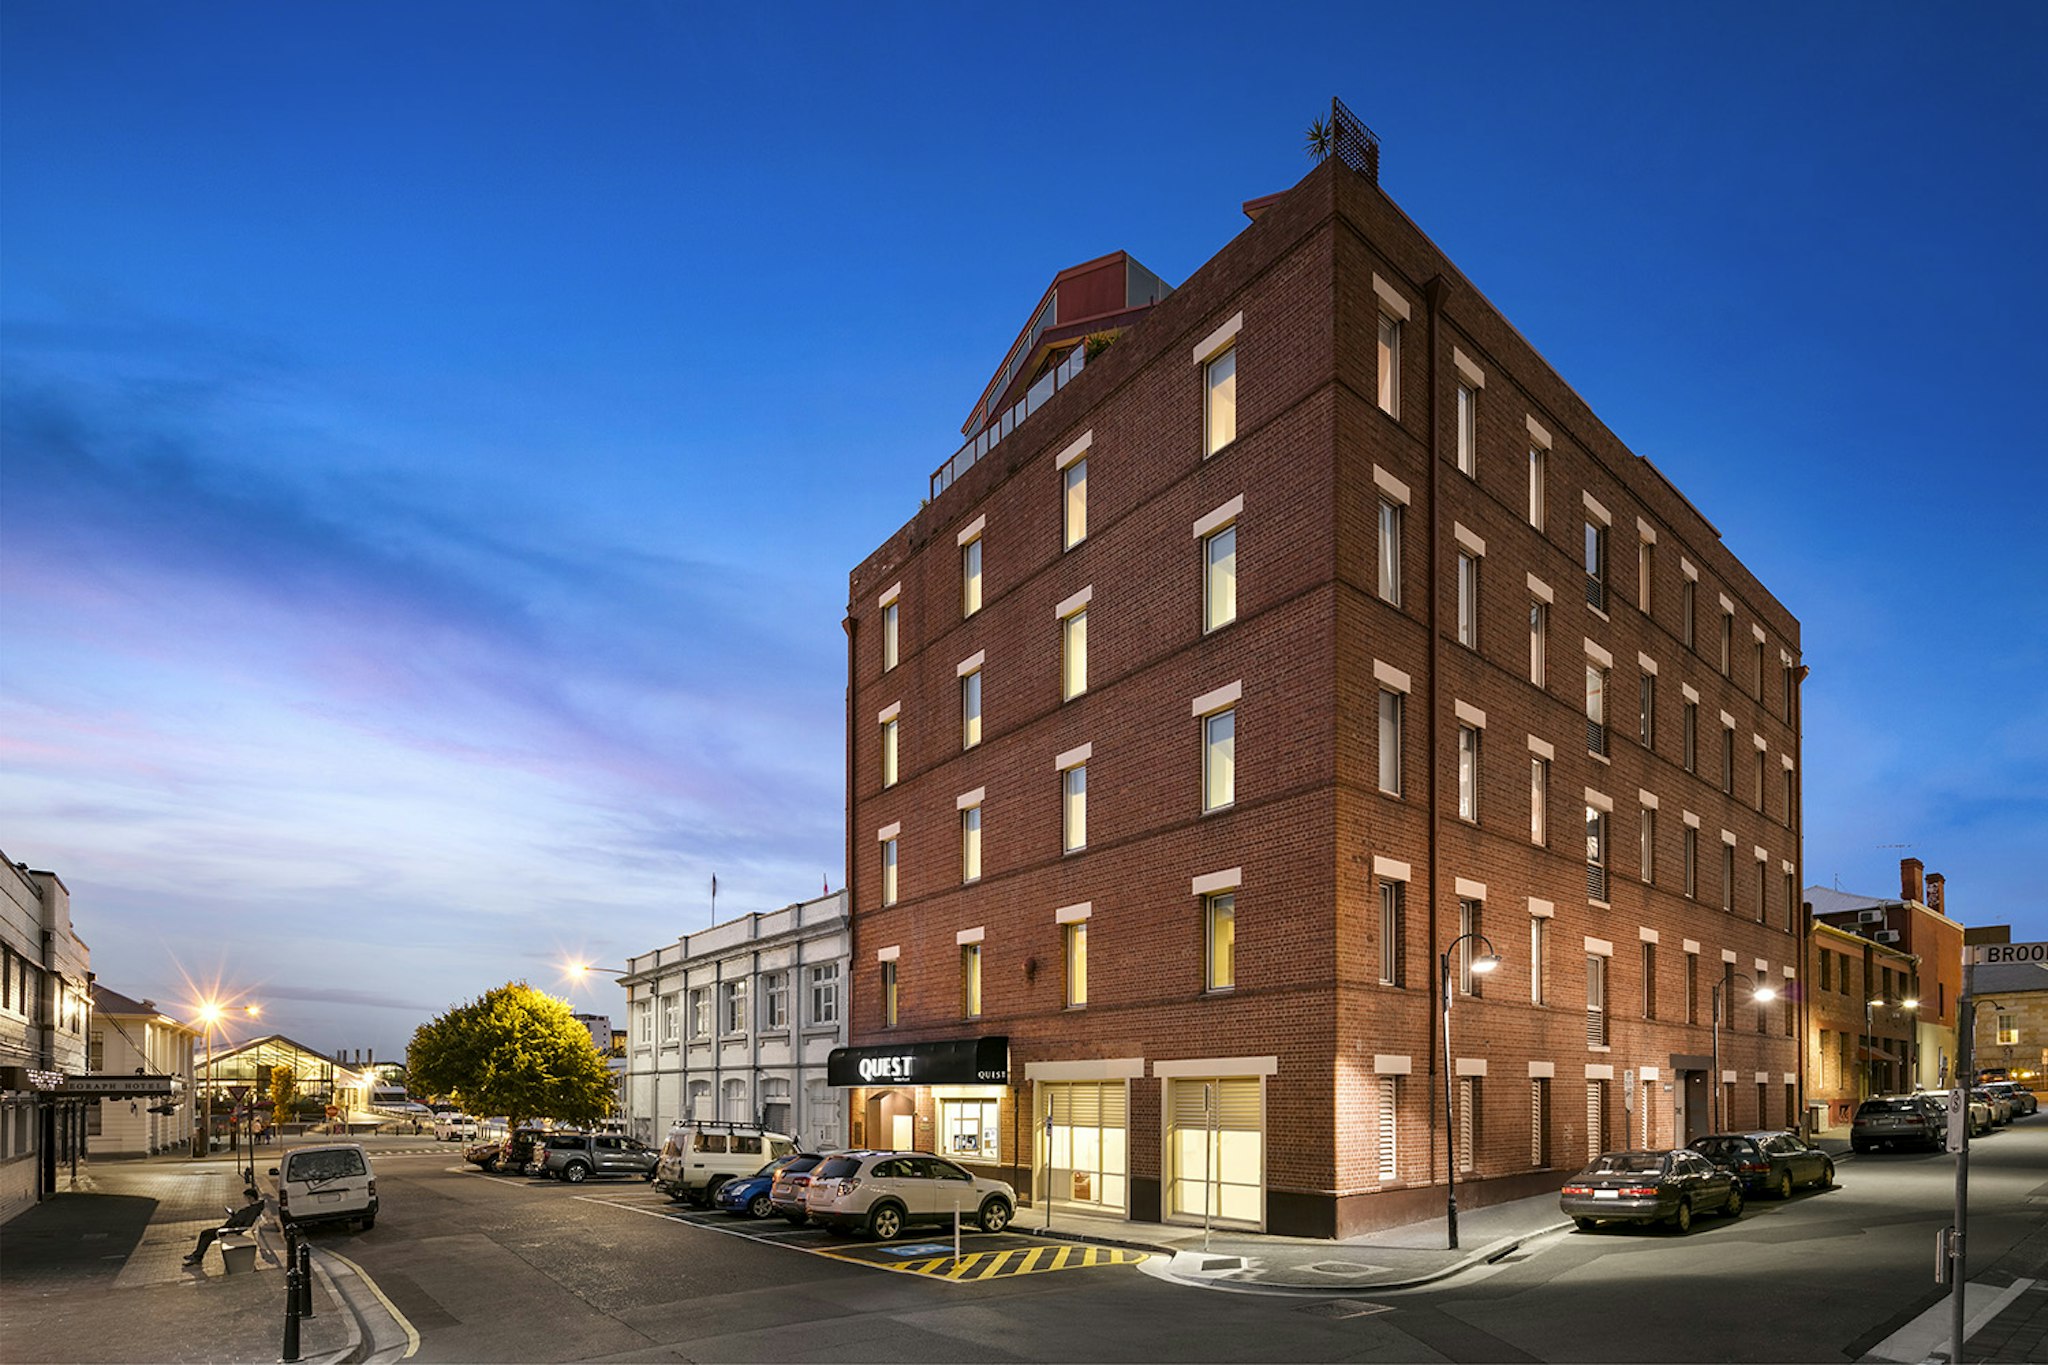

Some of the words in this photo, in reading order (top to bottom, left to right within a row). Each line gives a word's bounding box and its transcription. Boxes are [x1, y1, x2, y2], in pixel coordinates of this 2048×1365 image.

[1988, 945, 2048, 962] BROO
[859, 1056, 914, 1081] QUEST
[125, 1082, 163, 1090] HOTEL
